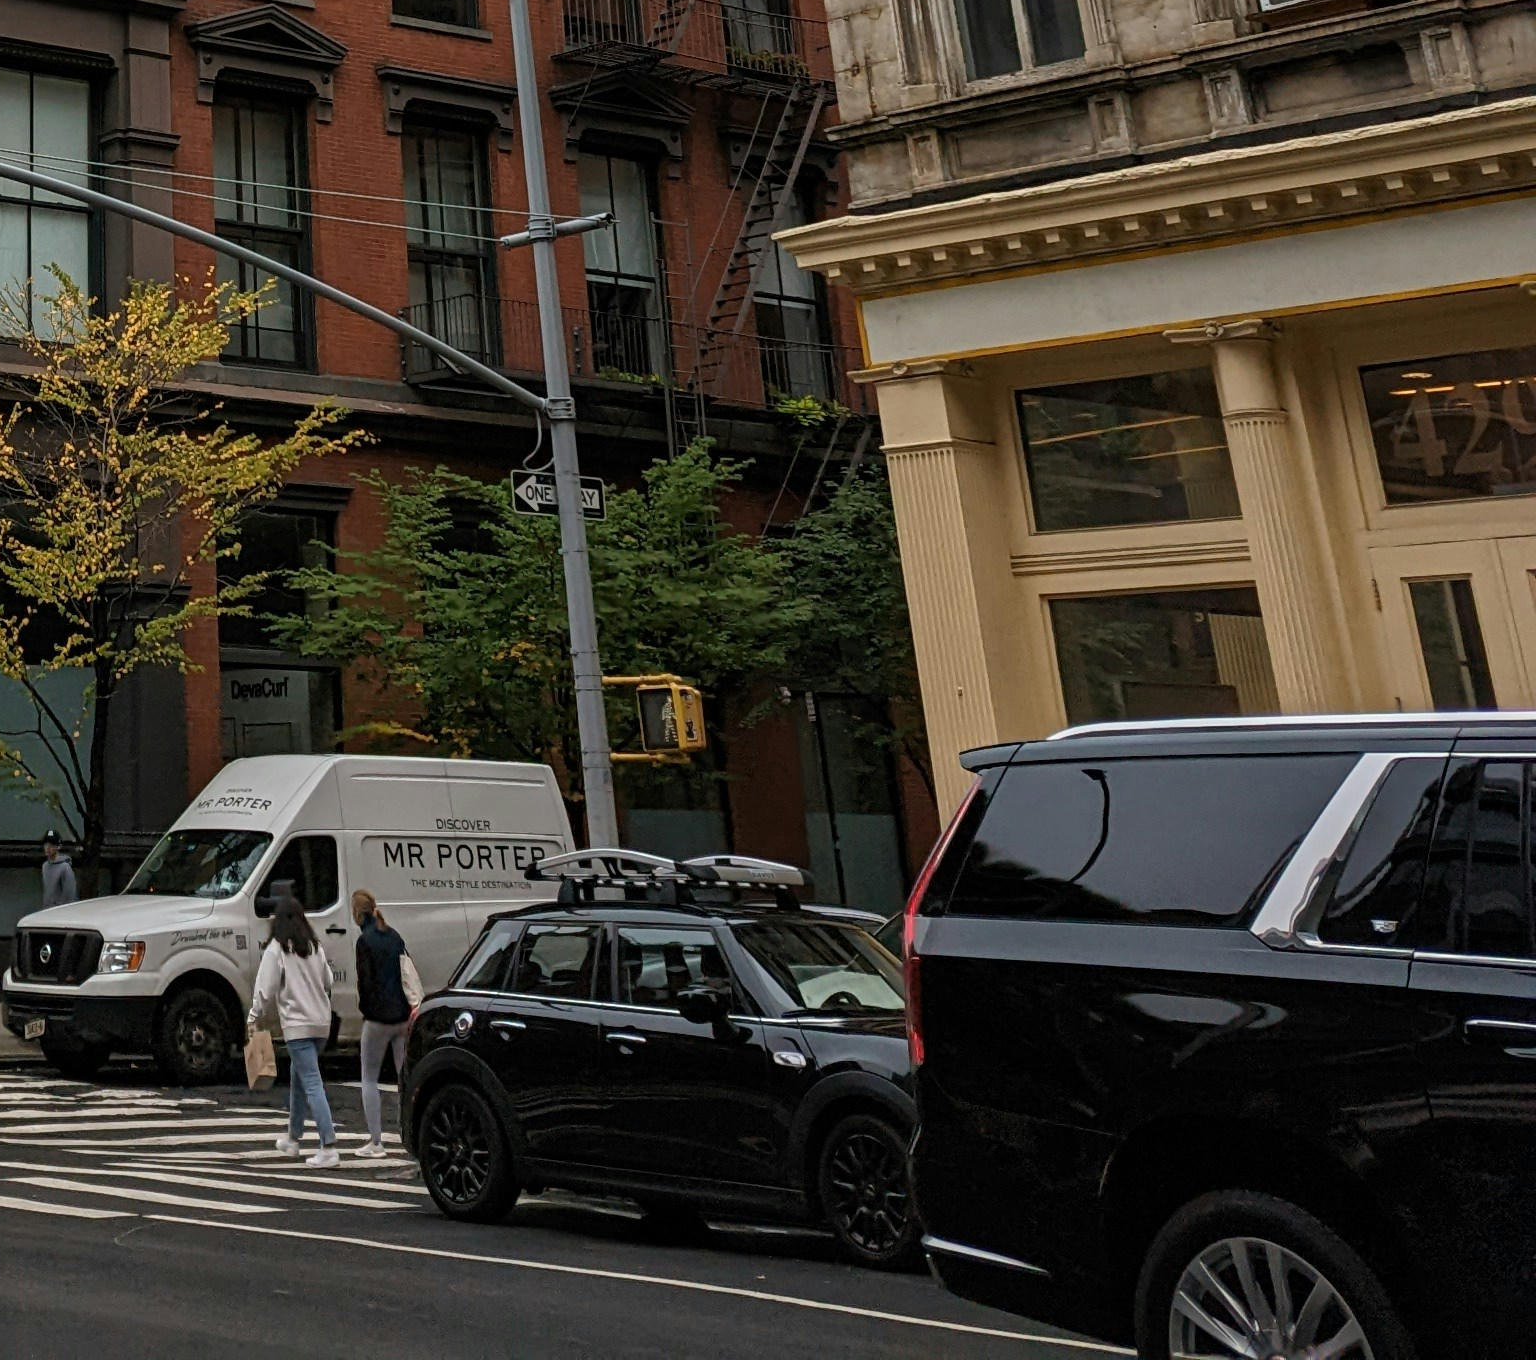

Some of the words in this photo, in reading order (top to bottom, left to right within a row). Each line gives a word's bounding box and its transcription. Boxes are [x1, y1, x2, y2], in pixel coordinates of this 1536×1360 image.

[525, 484, 553, 502] ONE
[581, 489, 595, 506] AY
[230, 676, 290, 699] DevaCurl
[215, 796, 272, 811] PORTER
[436, 819, 491, 831] DISCOVER
[383, 842, 425, 868] MR
[411, 879, 427, 887] THE
[429, 879, 454, 888] MEN'S
[456, 880, 479, 888] STYLE
[482, 881, 532, 890] DESTINATION
